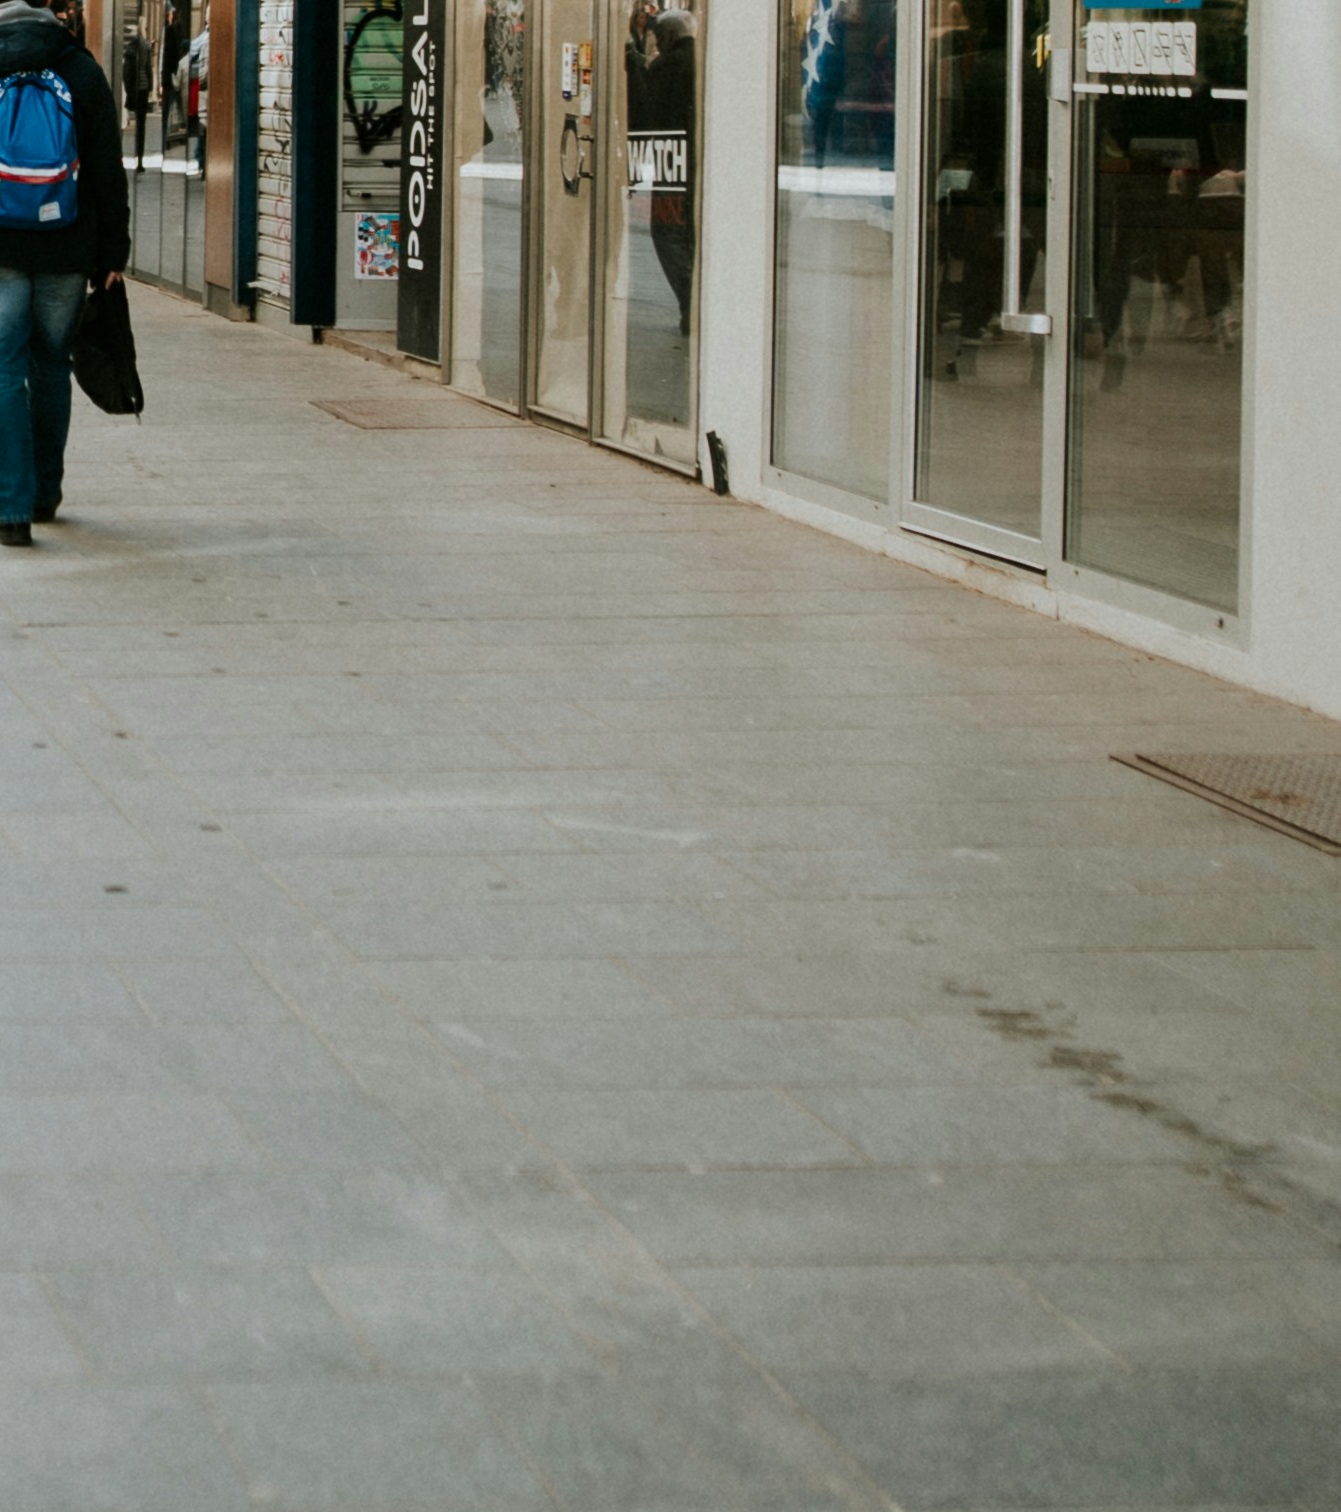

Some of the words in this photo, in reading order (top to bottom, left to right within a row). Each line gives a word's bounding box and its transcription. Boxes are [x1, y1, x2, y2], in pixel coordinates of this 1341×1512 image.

[428, 40, 436, 97] SPOT
[427, 113, 435, 146] THE
[426, 155, 434, 190] HIT
[627, 139, 687, 183] WATCH
